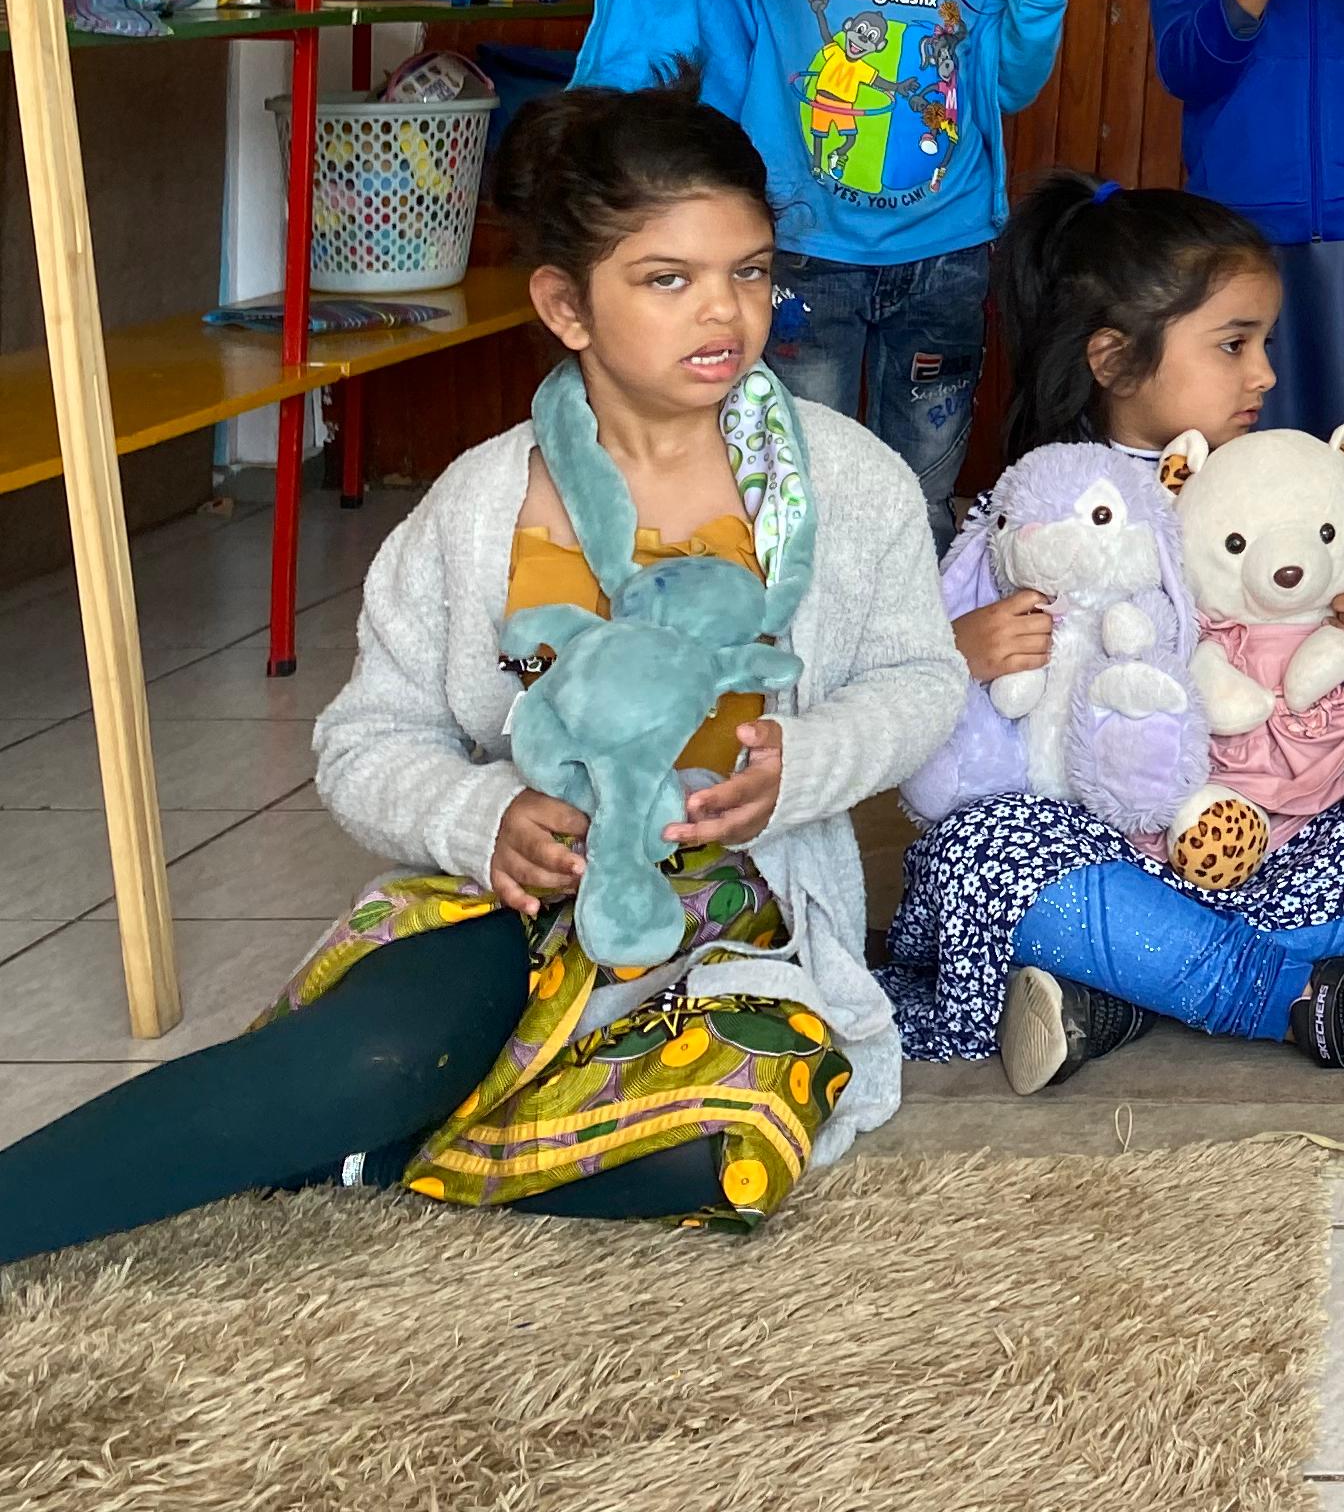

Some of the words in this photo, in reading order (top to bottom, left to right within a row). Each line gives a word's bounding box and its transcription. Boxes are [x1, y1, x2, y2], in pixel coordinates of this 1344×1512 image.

[833, 183, 861, 207] YES,
[868, 196, 897, 208] YOU
[901, 187, 926, 206] CAN!
[1315, 984, 1331, 1060] SKECHERS
